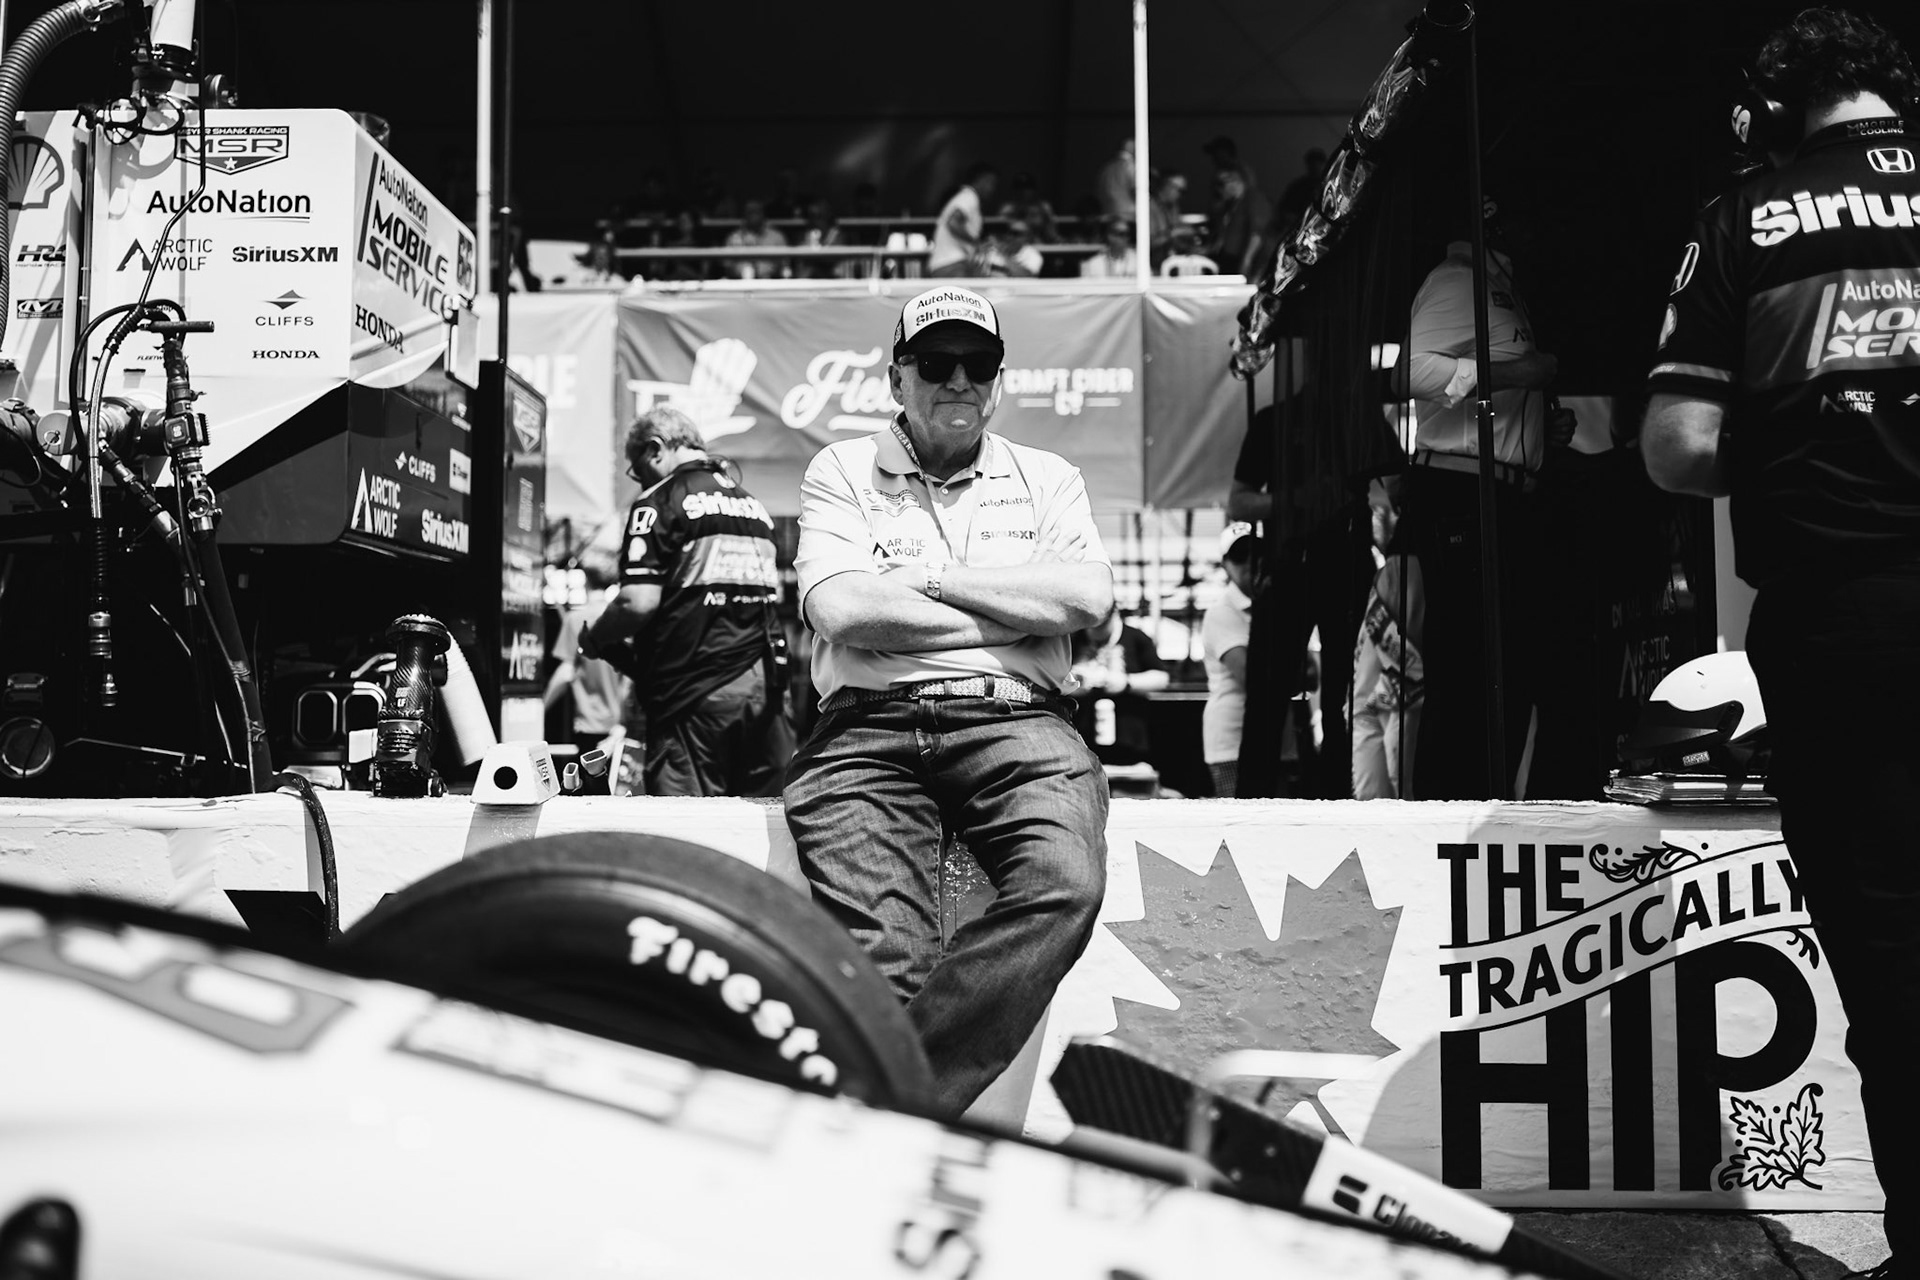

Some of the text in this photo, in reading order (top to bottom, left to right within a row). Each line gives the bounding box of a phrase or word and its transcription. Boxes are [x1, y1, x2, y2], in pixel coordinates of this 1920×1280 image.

[212, 126, 247, 136] SHANK
[249, 126, 287, 136] RACING
[1859, 127, 1904, 136] COOLING
[180, 138, 283, 153] MSR
[146, 189, 311, 213] AutoNation
[379, 159, 428, 227] AutoNation
[152, 239, 213, 254] ARCTIC
[372, 199, 448, 285] MOBILE
[232, 246, 339, 262] SiriusXM
[157, 257, 207, 271] WOLF
[917, 292, 982, 310] AutoNation
[255, 316, 314, 326] CLIFFS
[916, 308, 986, 327] SiriusXM
[1832, 307, 1920, 334] MO
[355, 304, 404, 354] HONDA
[252, 350, 320, 359] HONDA
[408, 455, 436, 484] CLIFFS
[370, 474, 401, 510] ARCTIC
[979, 496, 1034, 508] utoNatio
[373, 506, 398, 538] WOLF
[421, 508, 470, 554] SiriusXM
[887, 537, 927, 548] ARTIC
[892, 547, 923, 558] WOLF
[1436, 843, 1585, 947] THE
[1438, 859, 1808, 1019] TRAGICALLY
[1440, 939, 1819, 1192] HIP
